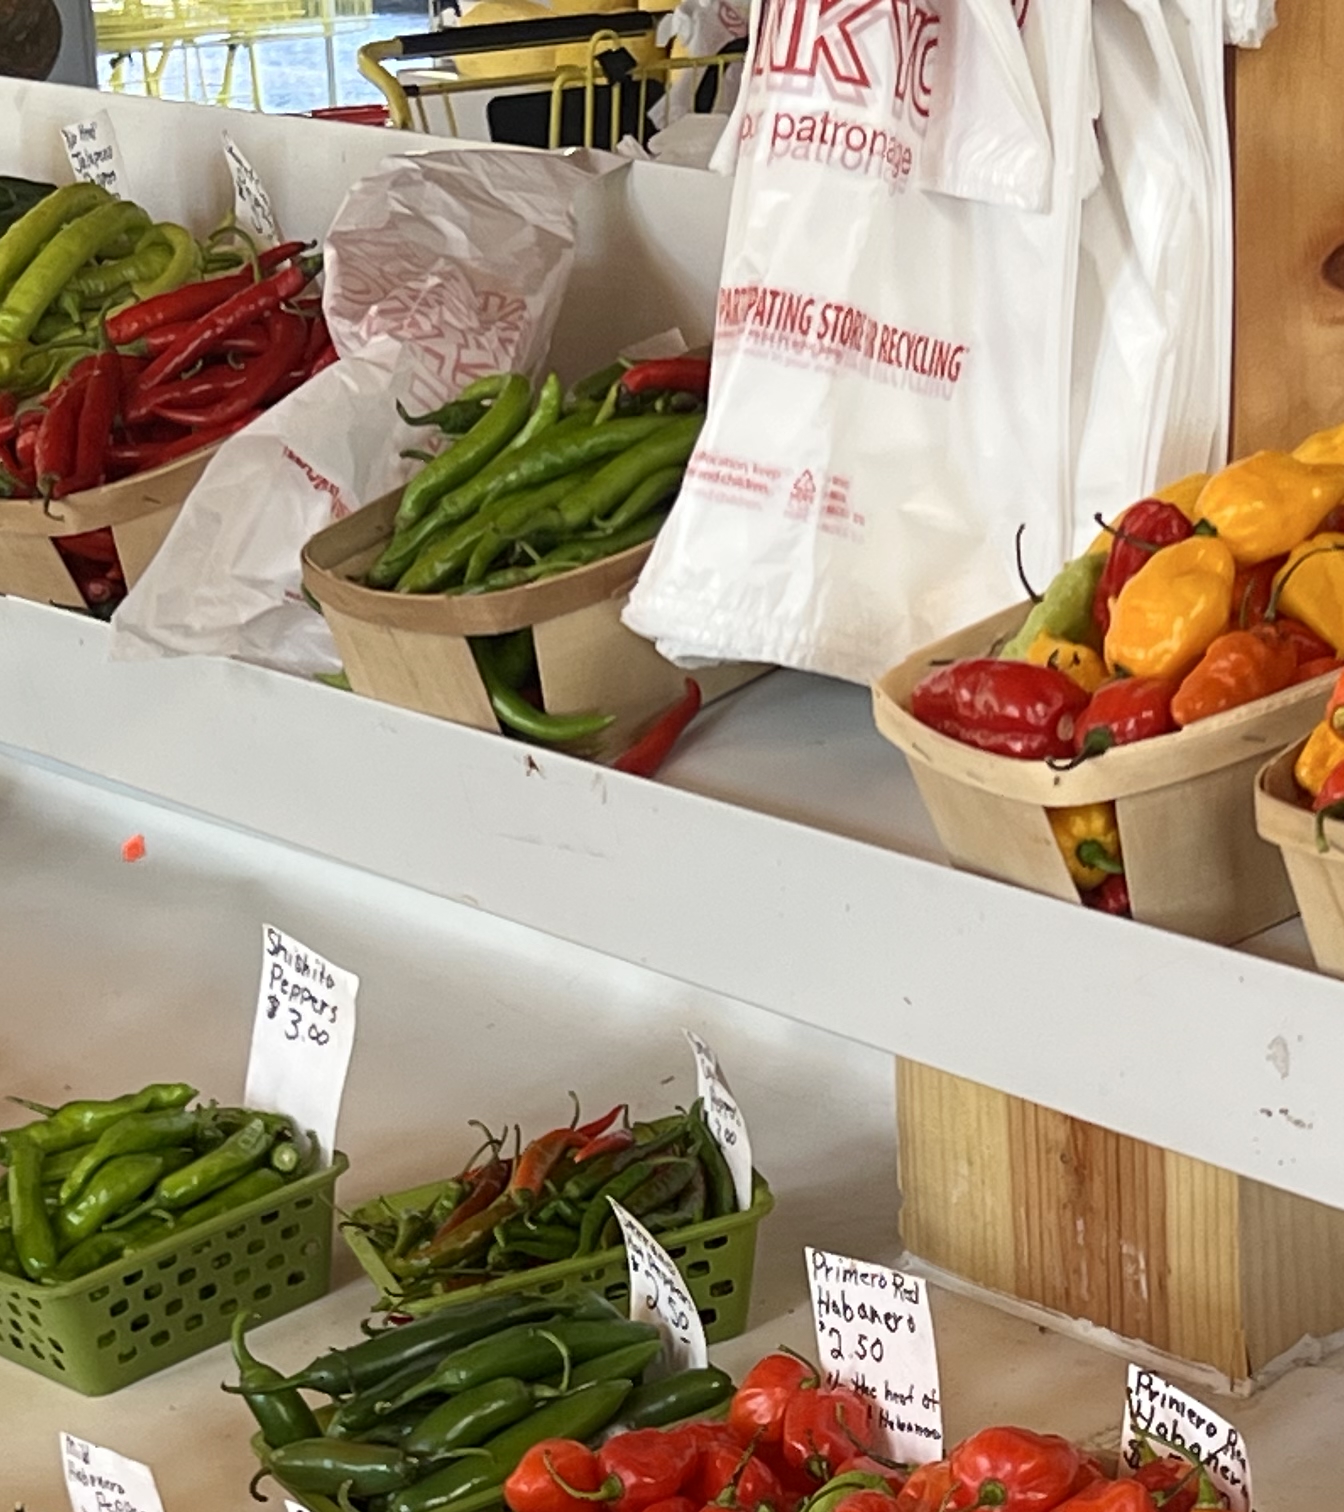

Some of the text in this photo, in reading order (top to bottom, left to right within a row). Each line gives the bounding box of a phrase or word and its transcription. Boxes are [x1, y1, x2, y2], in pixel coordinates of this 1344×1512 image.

[771, 110, 913, 179] patronage
[880, 324, 966, 383] RECYCLING
[266, 927, 336, 990] Shishito
[268, 962, 338, 1024] Peppers
[811, 1251, 920, 1305] Primero Red
[817, 1284, 916, 1334] Habanero
[1136, 1370, 1217, 1438] Primero
